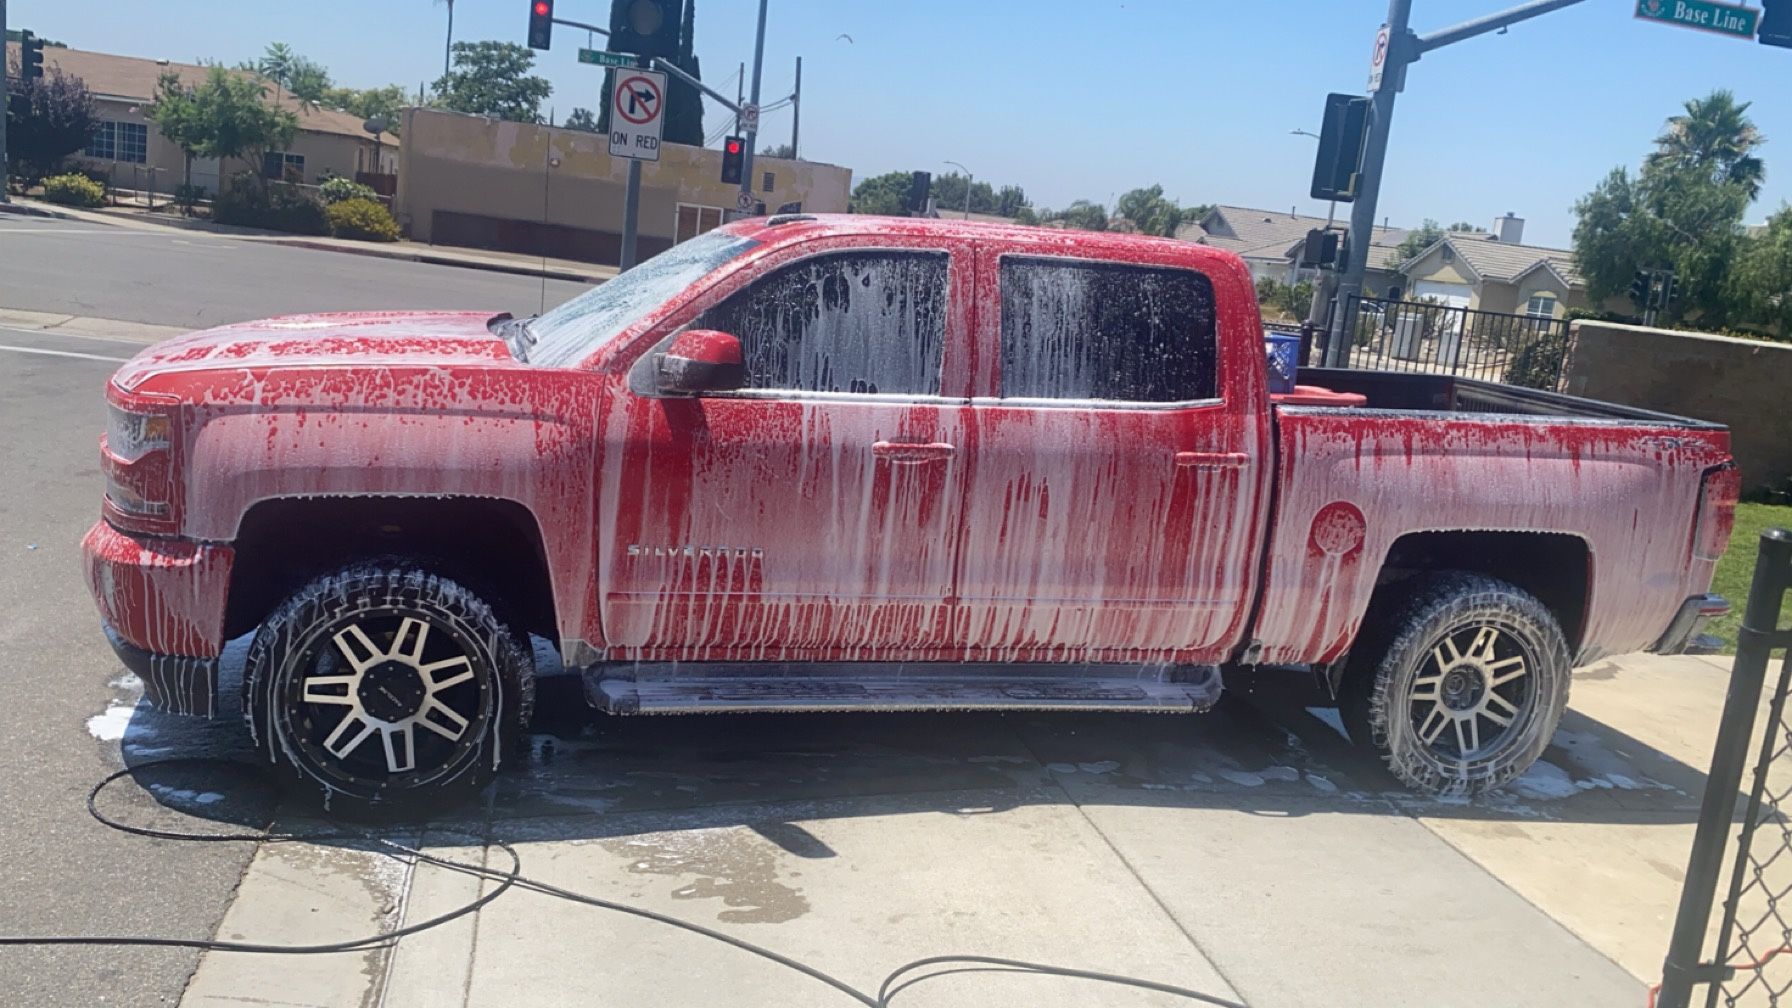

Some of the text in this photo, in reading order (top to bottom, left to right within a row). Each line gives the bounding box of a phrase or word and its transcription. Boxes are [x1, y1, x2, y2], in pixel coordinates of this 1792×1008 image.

[1674, 1, 1708, 23] Base
[1713, 8, 1746, 31] Line
[600, 54, 618, 64] Base
[612, 131, 658, 150] ON RED
